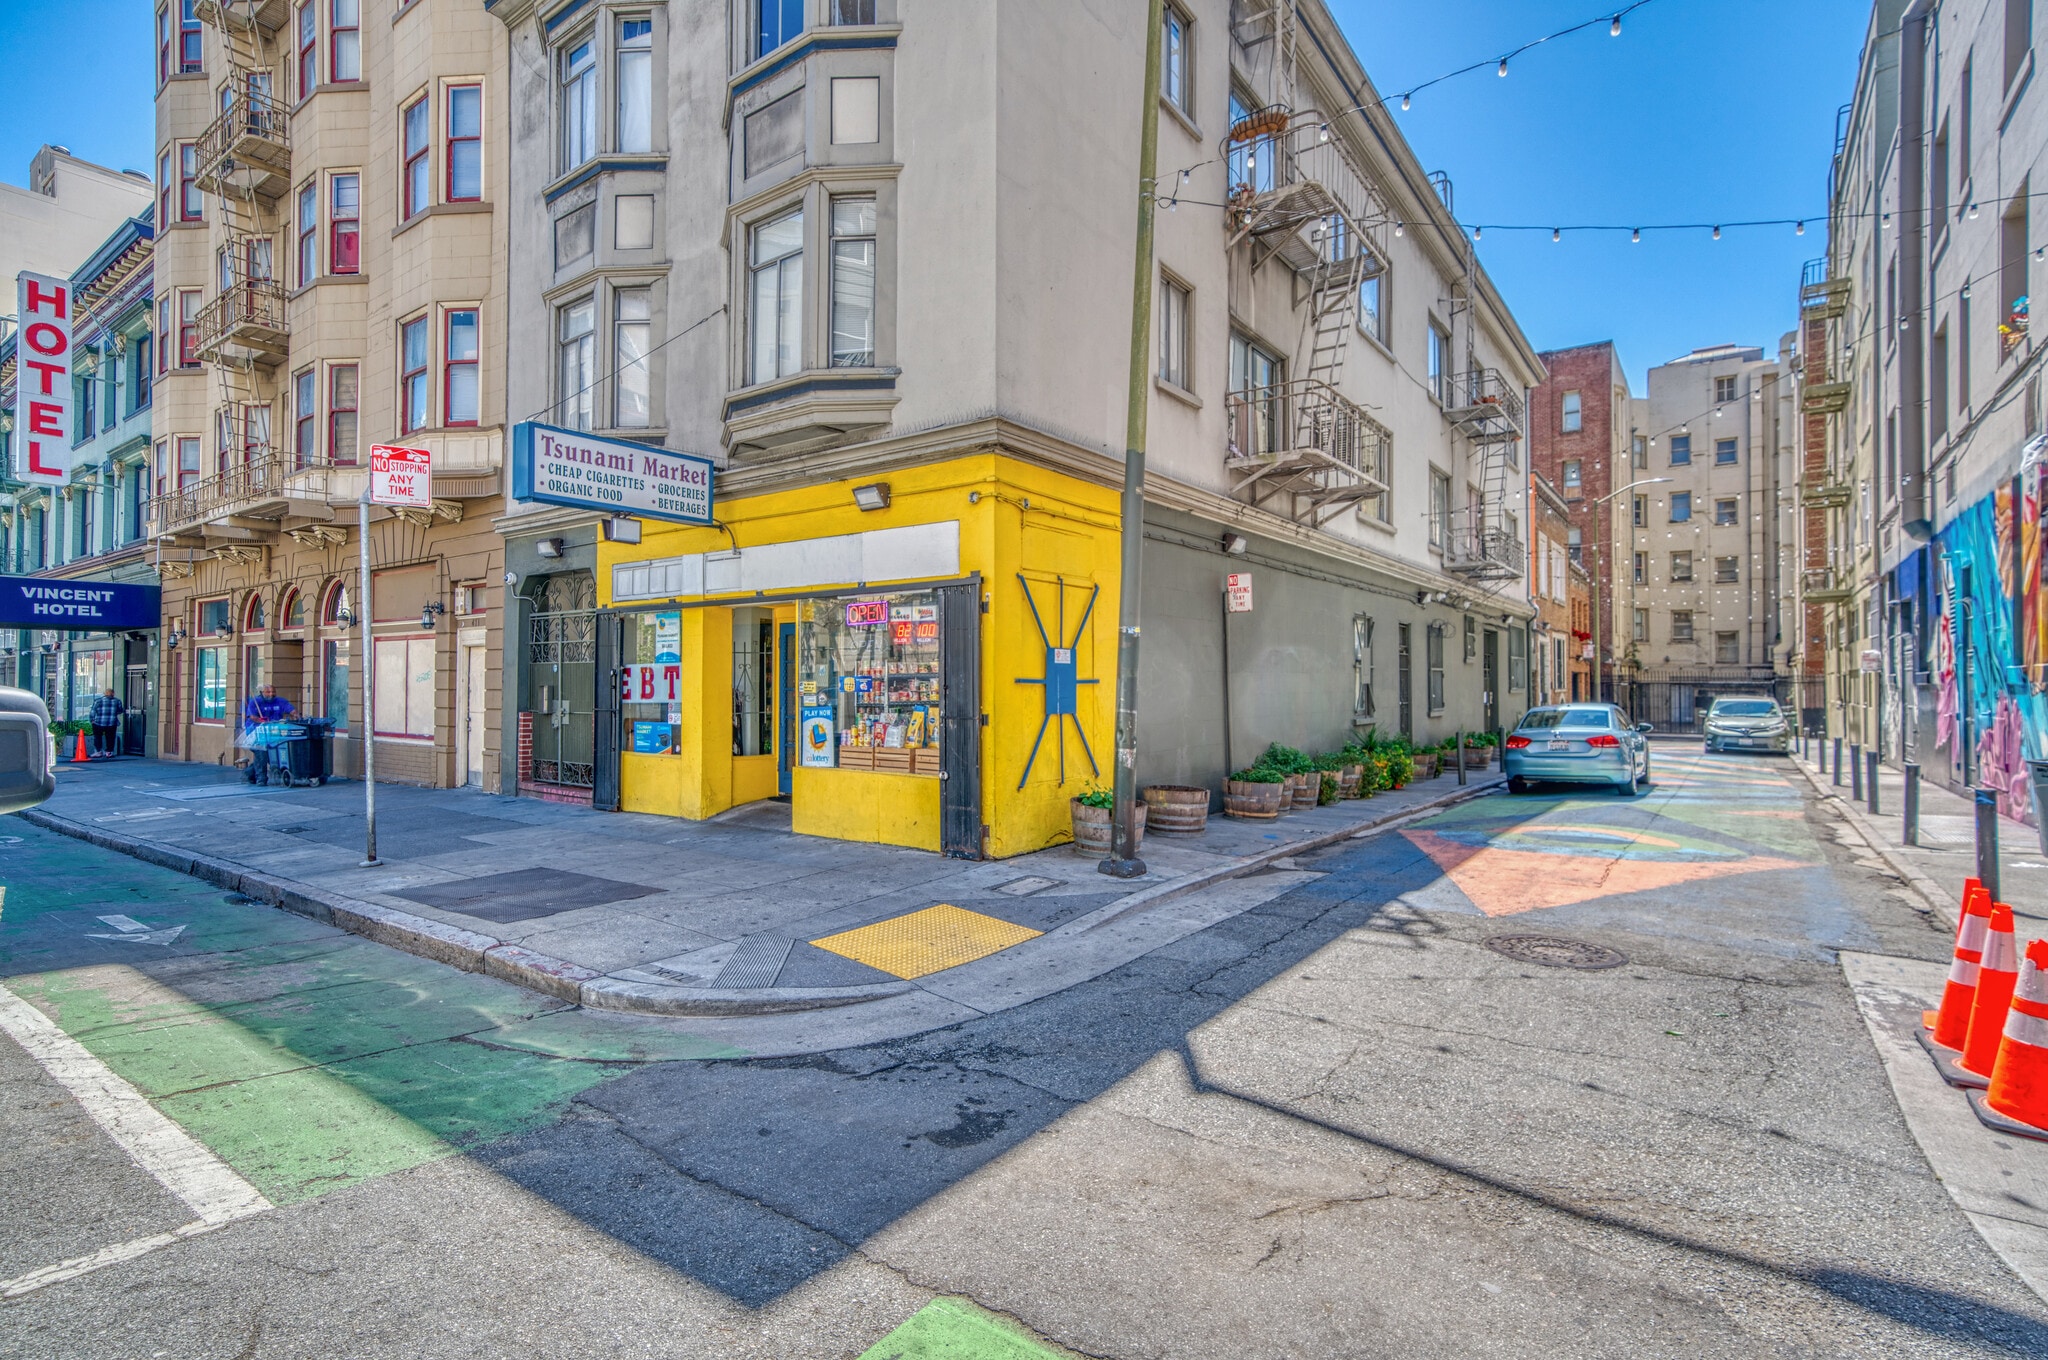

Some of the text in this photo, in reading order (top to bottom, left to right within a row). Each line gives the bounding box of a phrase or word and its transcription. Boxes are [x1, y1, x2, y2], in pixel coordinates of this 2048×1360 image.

[25, 279, 68, 477] HOTEL
[373, 457, 427, 475] NO STOPPING
[541, 434, 707, 486] Tsunami Market
[388, 474, 414, 485] ANY
[548, 462, 645, 491] CHEAP CIGARETTES
[388, 485, 414, 496] TIME
[548, 478, 623, 502] ORGANIC FOOD
[657, 483, 706, 501] GROCERIES
[658, 497, 706, 515] BEVERAGES
[1229, 576, 1237, 585] NO
[21, 586, 114, 603] VINCENT
[33, 602, 102, 617] HOTEL
[849, 603, 886, 623] OPEN
[897, 624, 912, 637] 82
[917, 623, 936, 637] 100
[622, 665, 680, 700] EBT
